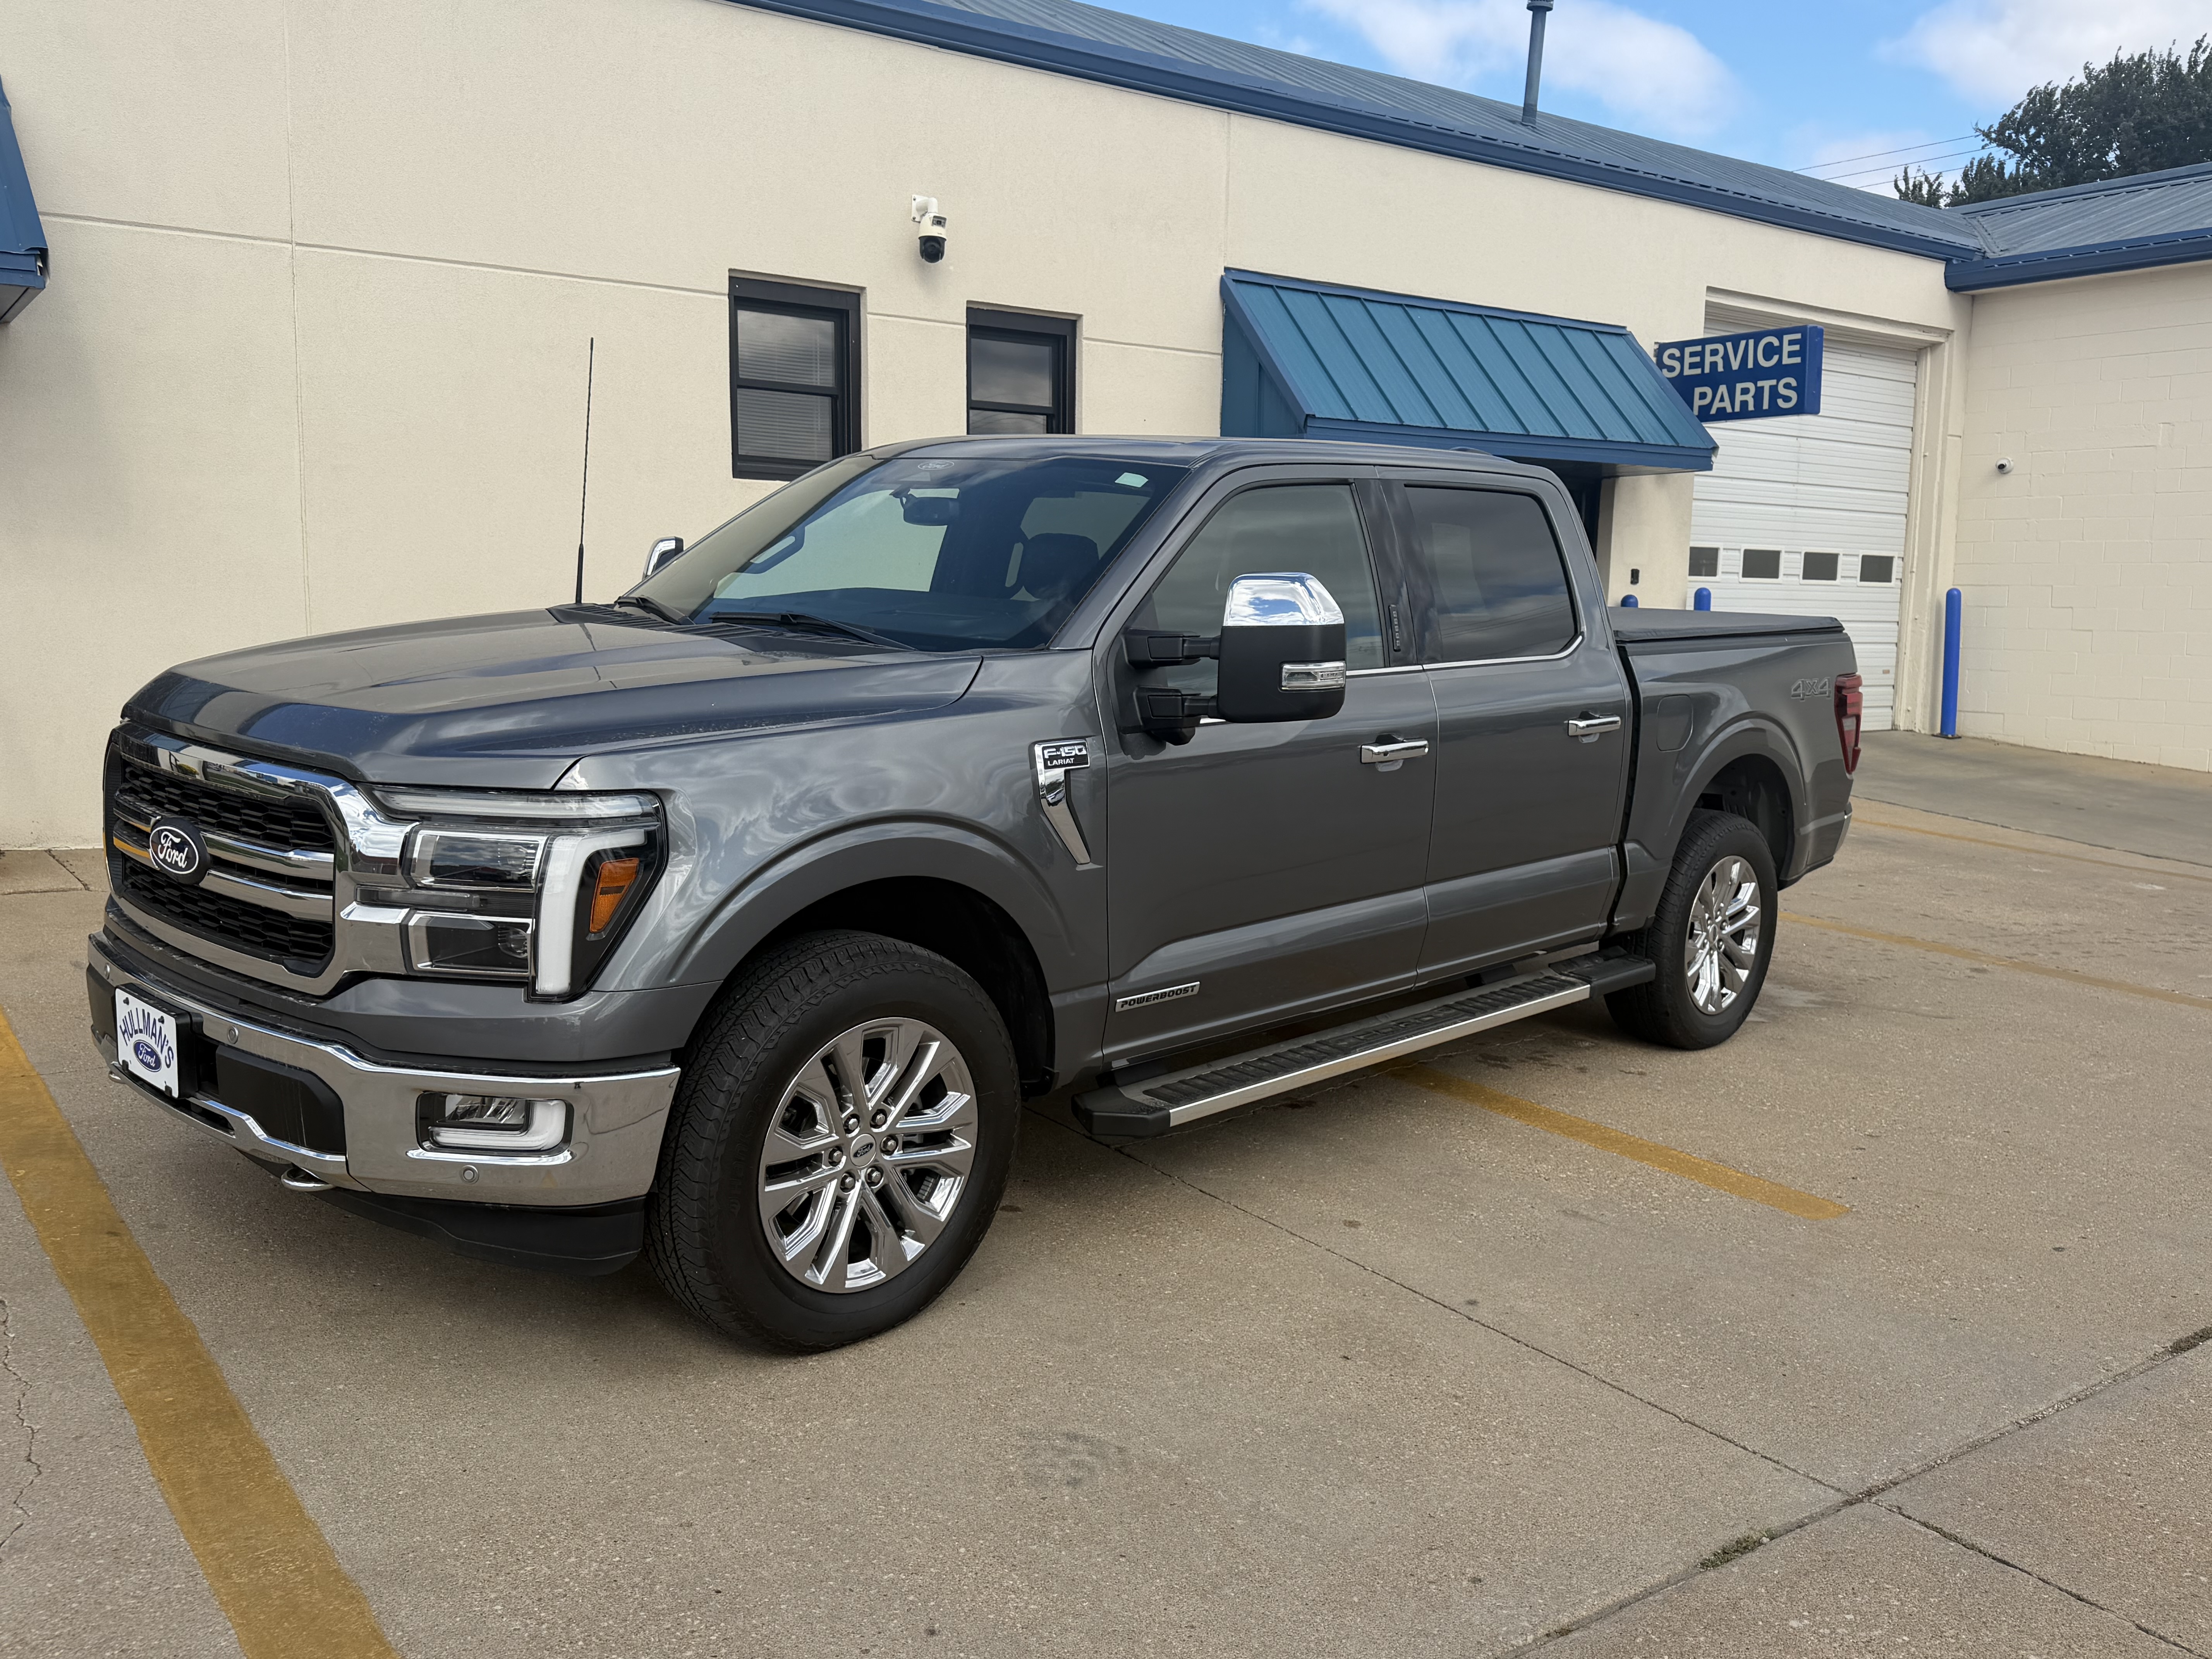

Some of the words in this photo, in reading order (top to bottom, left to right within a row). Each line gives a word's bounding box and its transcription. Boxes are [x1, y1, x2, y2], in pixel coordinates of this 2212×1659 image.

[1662, 333, 1802, 378] SERVICE
[1693, 377, 1798, 416] PARTS
[1044, 745, 1087, 759] F-150
[1048, 758, 1075, 766] LARIAT
[158, 831, 188, 868] Ford
[1120, 985, 1196, 1008] POWERBOOST
[119, 1007, 174, 1069] HULLMAN'S
[138, 1043, 156, 1067] Ford
[857, 1144, 871, 1157] Ford
